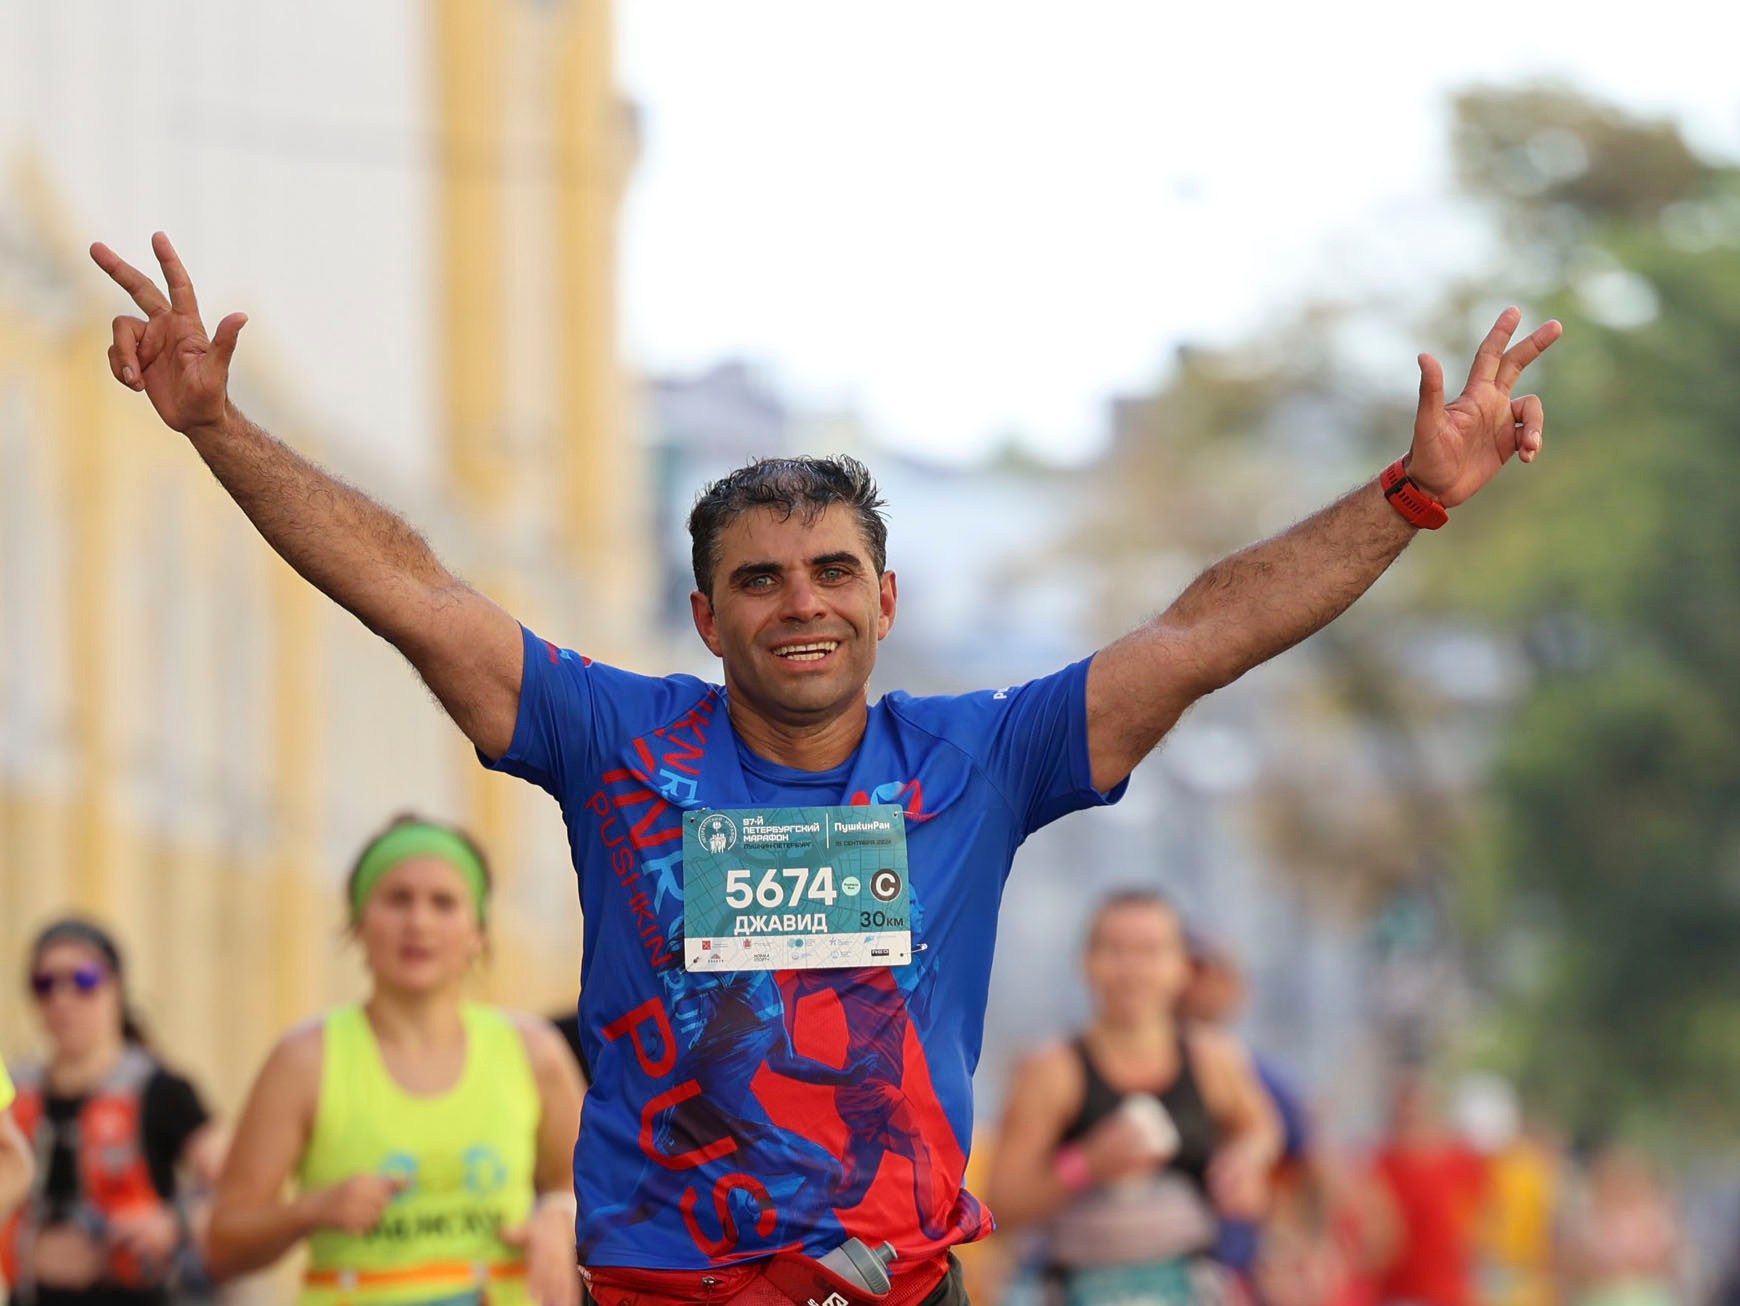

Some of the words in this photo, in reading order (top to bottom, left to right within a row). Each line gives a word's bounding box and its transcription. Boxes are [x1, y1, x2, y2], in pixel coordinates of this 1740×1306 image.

[743, 822, 820, 834] ПЕТЕРБУРГСКИЙ
[743, 834, 789, 843] МАРАФОН
[725, 867, 838, 909] 5674
[733, 913, 828, 936] ДЖАВИД
